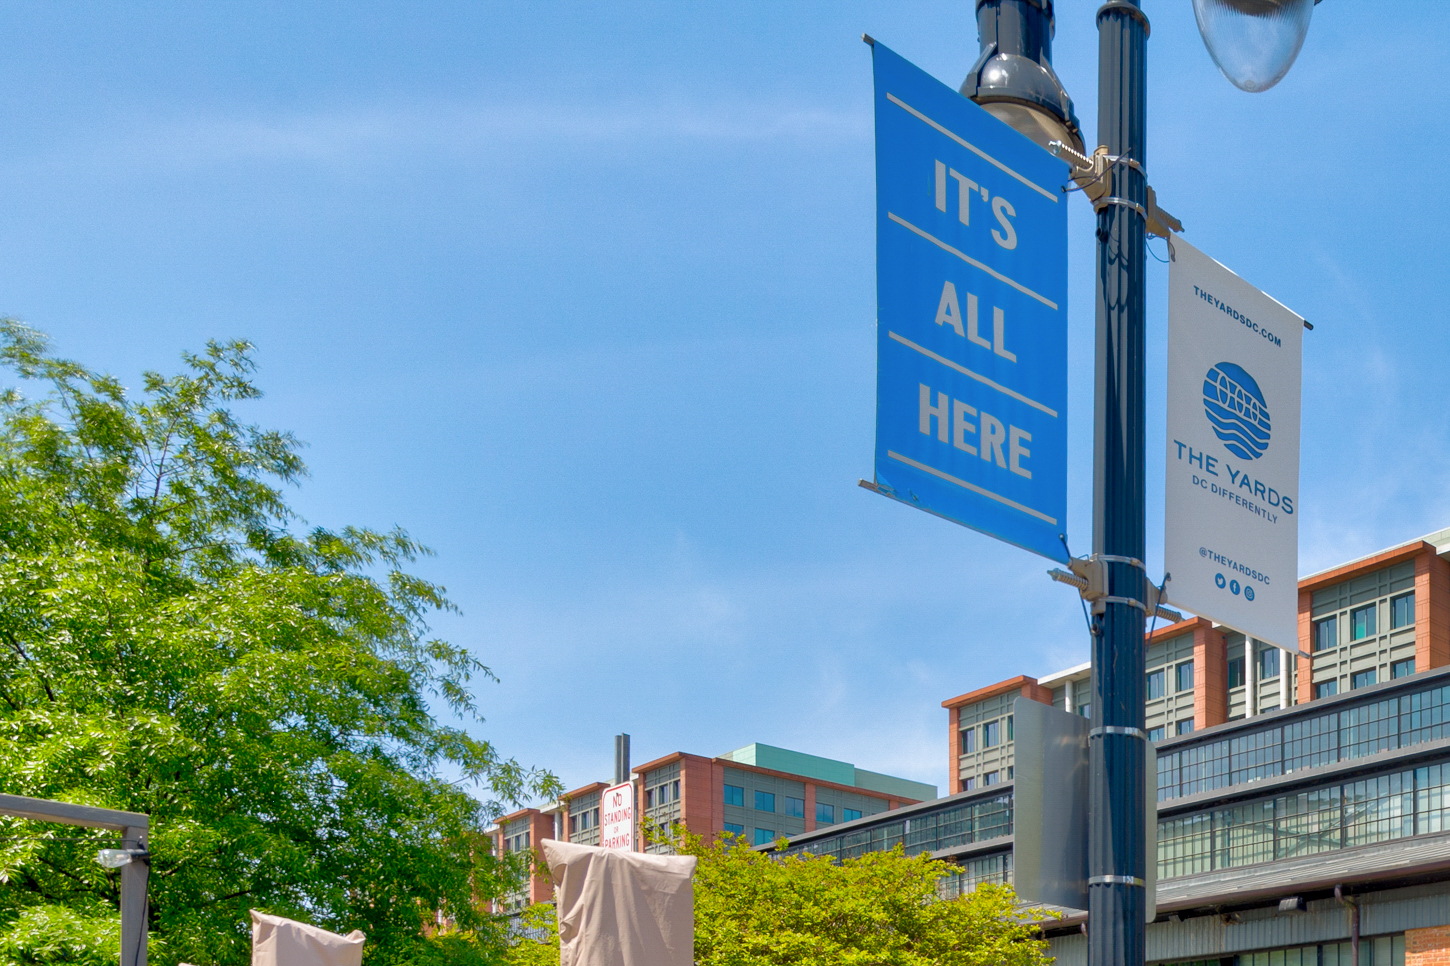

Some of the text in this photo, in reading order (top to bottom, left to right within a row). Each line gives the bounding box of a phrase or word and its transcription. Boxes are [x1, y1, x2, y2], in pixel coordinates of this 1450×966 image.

[935, 159, 1017, 250] IT'S
[935, 280, 1017, 363] ALL
[1193, 284, 1282, 348] THEYARDSDC.COM
[919, 382, 1032, 480] HERE
[1173, 439, 1294, 515] THE YARDS
[1192, 474, 1278, 524] DC DIFFERENTLY
[1199, 546, 1271, 585] @THEYARDSDC
[604, 806, 631, 827] STANDING
[612, 793, 622, 809] NO
[604, 832, 630, 849] PARKING
[613, 825, 619, 834] OR
